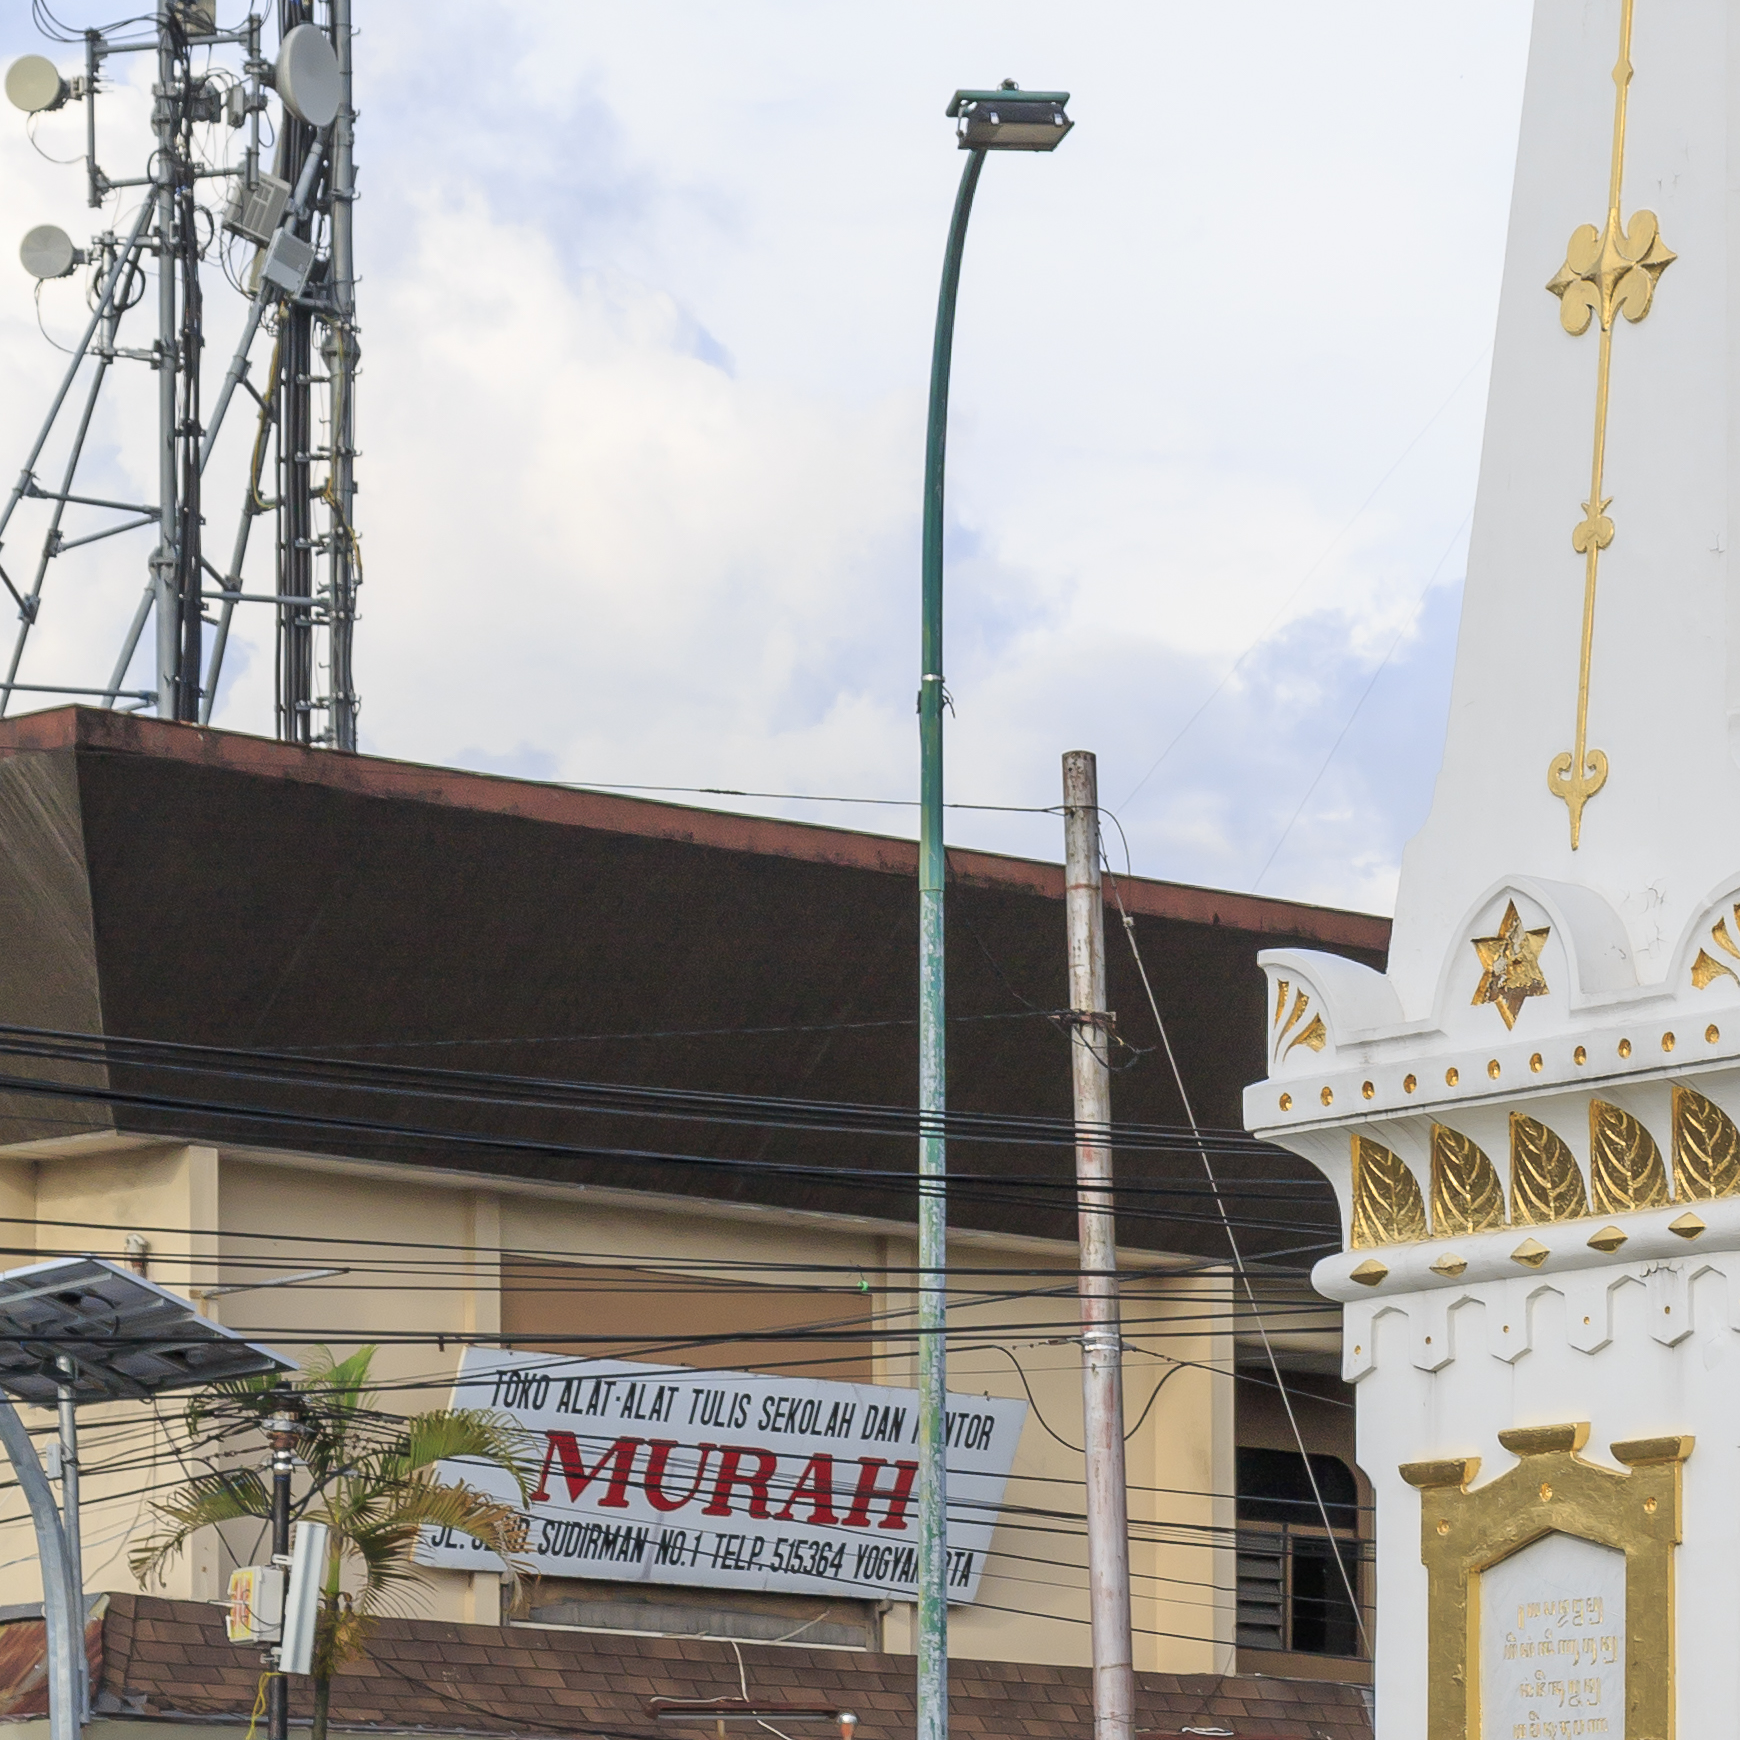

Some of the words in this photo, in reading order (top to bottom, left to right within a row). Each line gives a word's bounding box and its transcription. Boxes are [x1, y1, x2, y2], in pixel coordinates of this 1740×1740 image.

[491, 1371, 551, 1410] TOKO
[688, 1388, 752, 1429] TULIS
[758, 1395, 857, 1439] SEKOLAH
[860, 1404, 907, 1443] DAN
[531, 1430, 919, 1530] MURAH
[538, 1521, 649, 1564] SUDIRMAN
[771, 1538, 846, 1578] 515364
